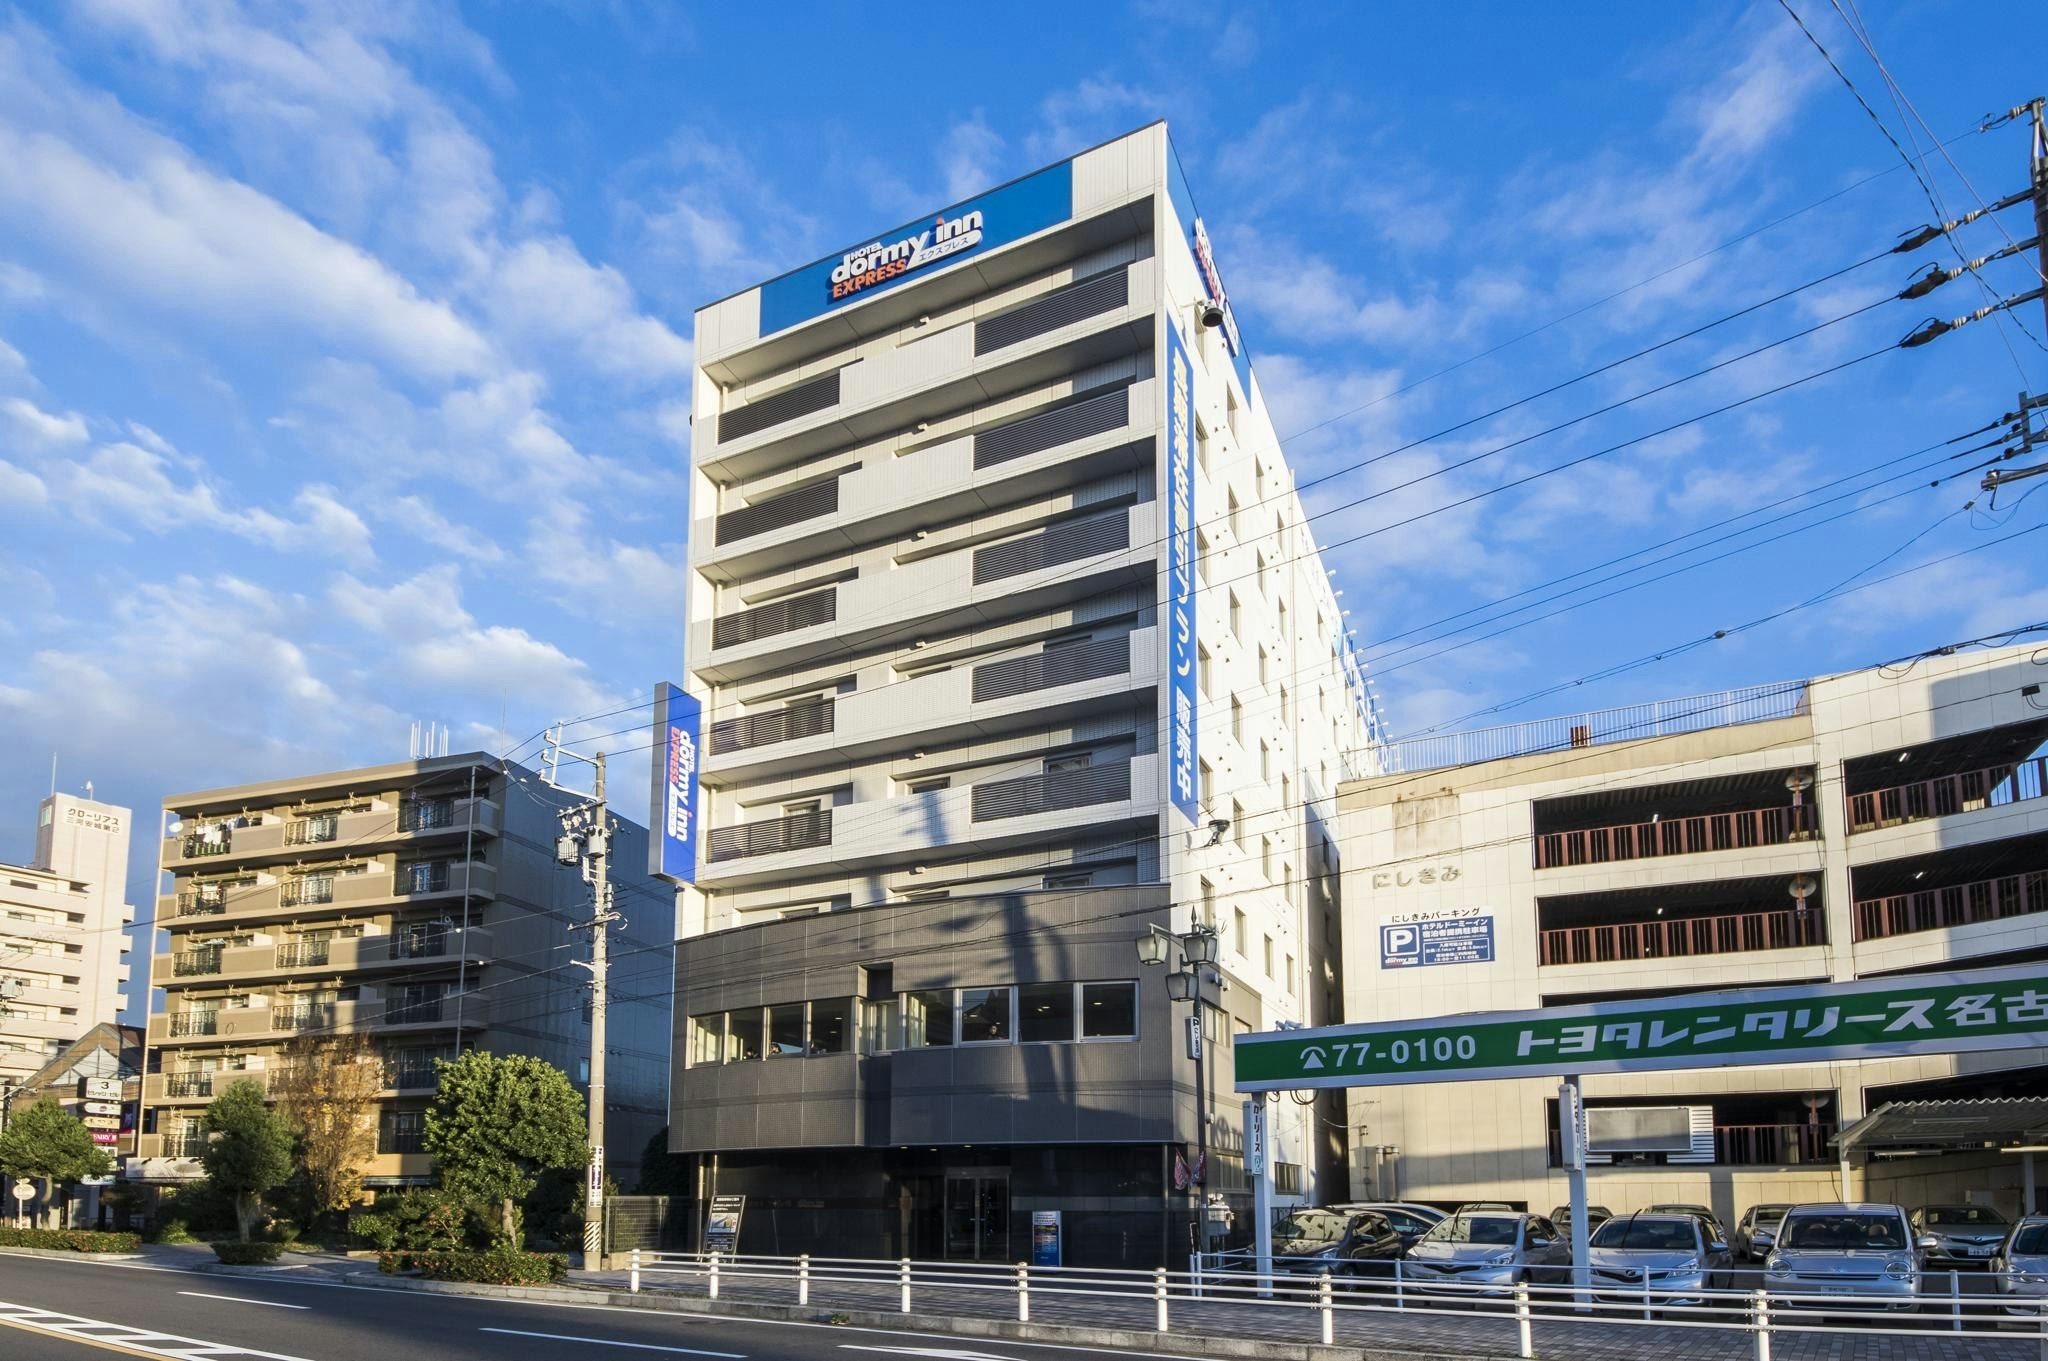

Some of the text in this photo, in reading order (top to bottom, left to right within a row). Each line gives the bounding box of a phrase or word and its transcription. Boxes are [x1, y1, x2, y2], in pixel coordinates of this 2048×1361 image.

[831, 210, 984, 283] dormy inn
[919, 236, 969, 262] エクスプレス
[832, 258, 908, 299] EXPRESS
[669, 725, 680, 784] EXPRESS
[676, 730, 696, 842] dormy inn
[1372, 865, 1462, 890] にしきみ
[1389, 929, 1413, 953] P
[1422, 919, 1488, 930] ホテルドーミーイン
[1331, 1034, 1477, 1068] 77-0100
